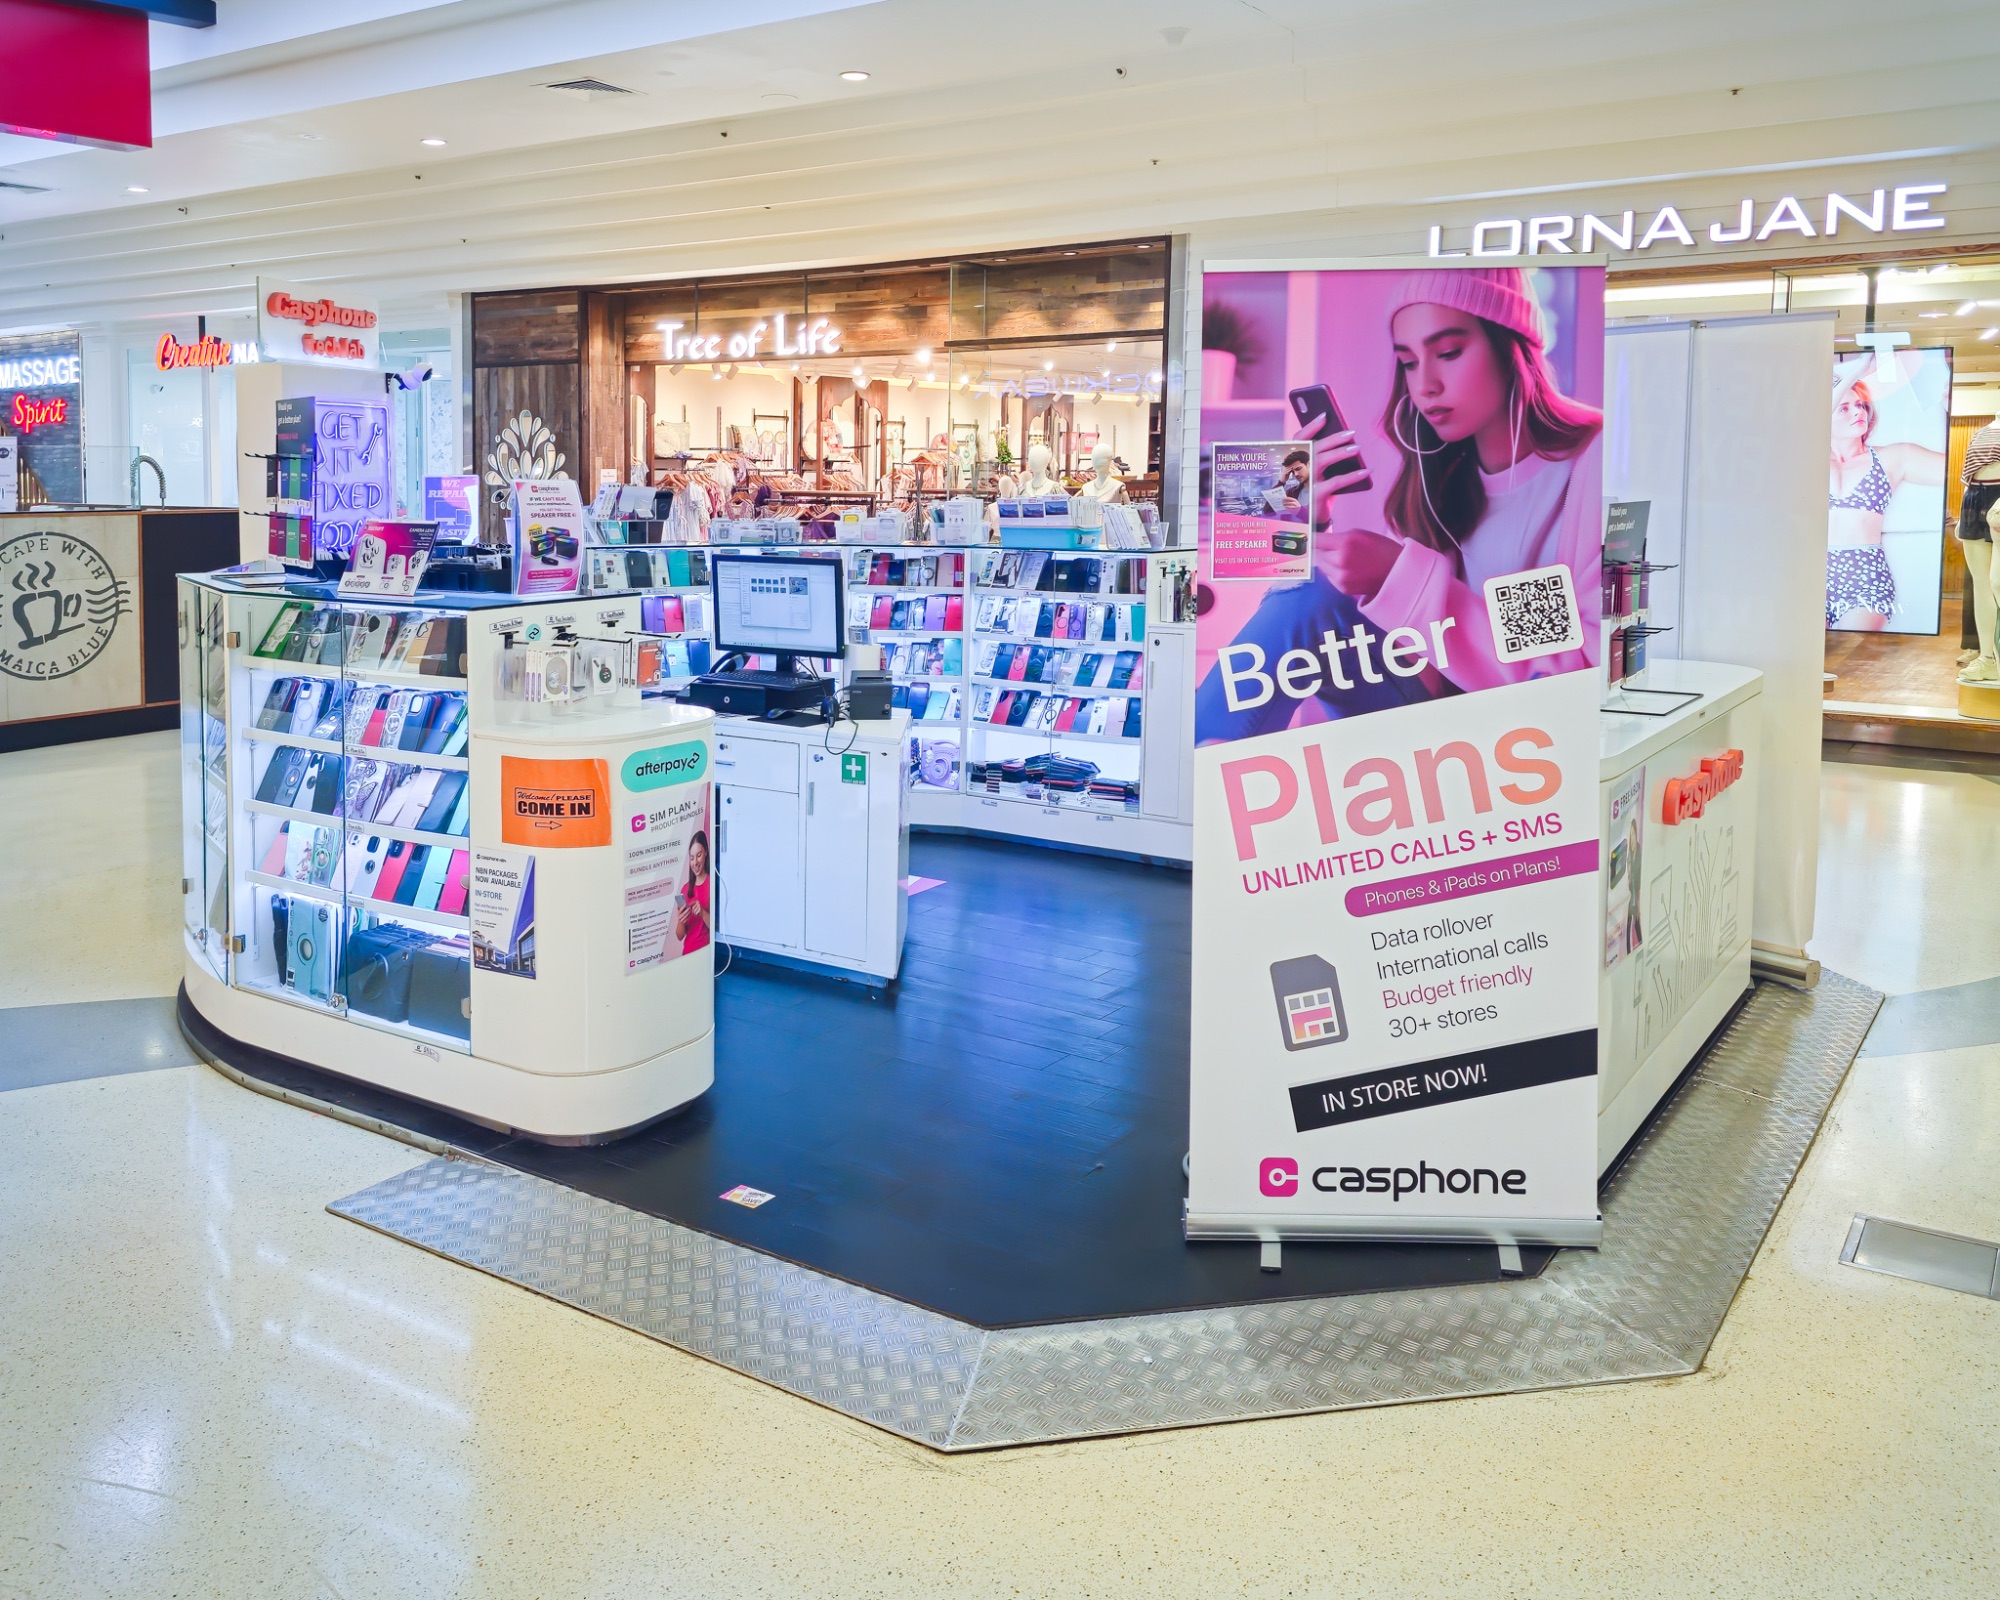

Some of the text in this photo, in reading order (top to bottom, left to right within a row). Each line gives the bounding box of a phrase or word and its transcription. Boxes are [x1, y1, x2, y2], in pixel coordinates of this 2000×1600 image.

[1428, 184, 1947, 257] LORNA JANE
[267, 292, 377, 328] Casphone
[156, 333, 259, 371] Creative NA
[656, 313, 842, 360] Tree of Life
[0, 357, 80, 389] MASSAGE
[13, 394, 67, 433] Spirit
[322, 411, 365, 440] GET
[333, 446, 356, 476] IT
[1216, 452, 1267, 462] THINK YOU'RE
[1216, 462, 1268, 472] OVERPAYING?
[312, 482, 383, 512] FIXED
[441, 479, 461, 488] WE
[0, 537, 107, 580] CAPE WITH
[1216, 540, 1268, 549] FREE SPEAKER
[1856, 593, 1909, 615] Now
[67, 626, 108, 667] BLUE
[1217, 616, 1457, 713] Better
[635, 757, 688, 777] afterpay
[516, 791, 556, 801] Welcome!
[1220, 727, 1564, 862] Plans
[1661, 748, 1745, 826] Casphone
[517, 801, 591, 816] COME IN
[649, 810, 666, 824] SIM
[668, 800, 691, 818] PLAN
[650, 806, 704, 833] PRODUCT BUNDLES
[628, 840, 681, 859] 100% INTEREST FREE
[1242, 812, 1564, 895] UNLIMITED CALLS + SMS
[475, 866, 518, 880] NBN PACKAGES
[629, 856, 678, 875] BUNDLE ANYTHING
[475, 875, 522, 888] NOW AVAILABLE
[475, 890, 503, 900] IN-STORE
[1365, 855, 1561, 908] Phones & iPads on Plans!
[1371, 911, 1494, 951] Data rollover
[637, 952, 664, 965] casphone
[1376, 931, 1549, 981] International calls
[1382, 964, 1534, 1010] Budget friendly
[1388, 1003, 1499, 1039] 30+ stores
[1321, 1063, 1488, 1114] IN STORE NOW!
[1311, 1160, 1527, 1203] casphone
